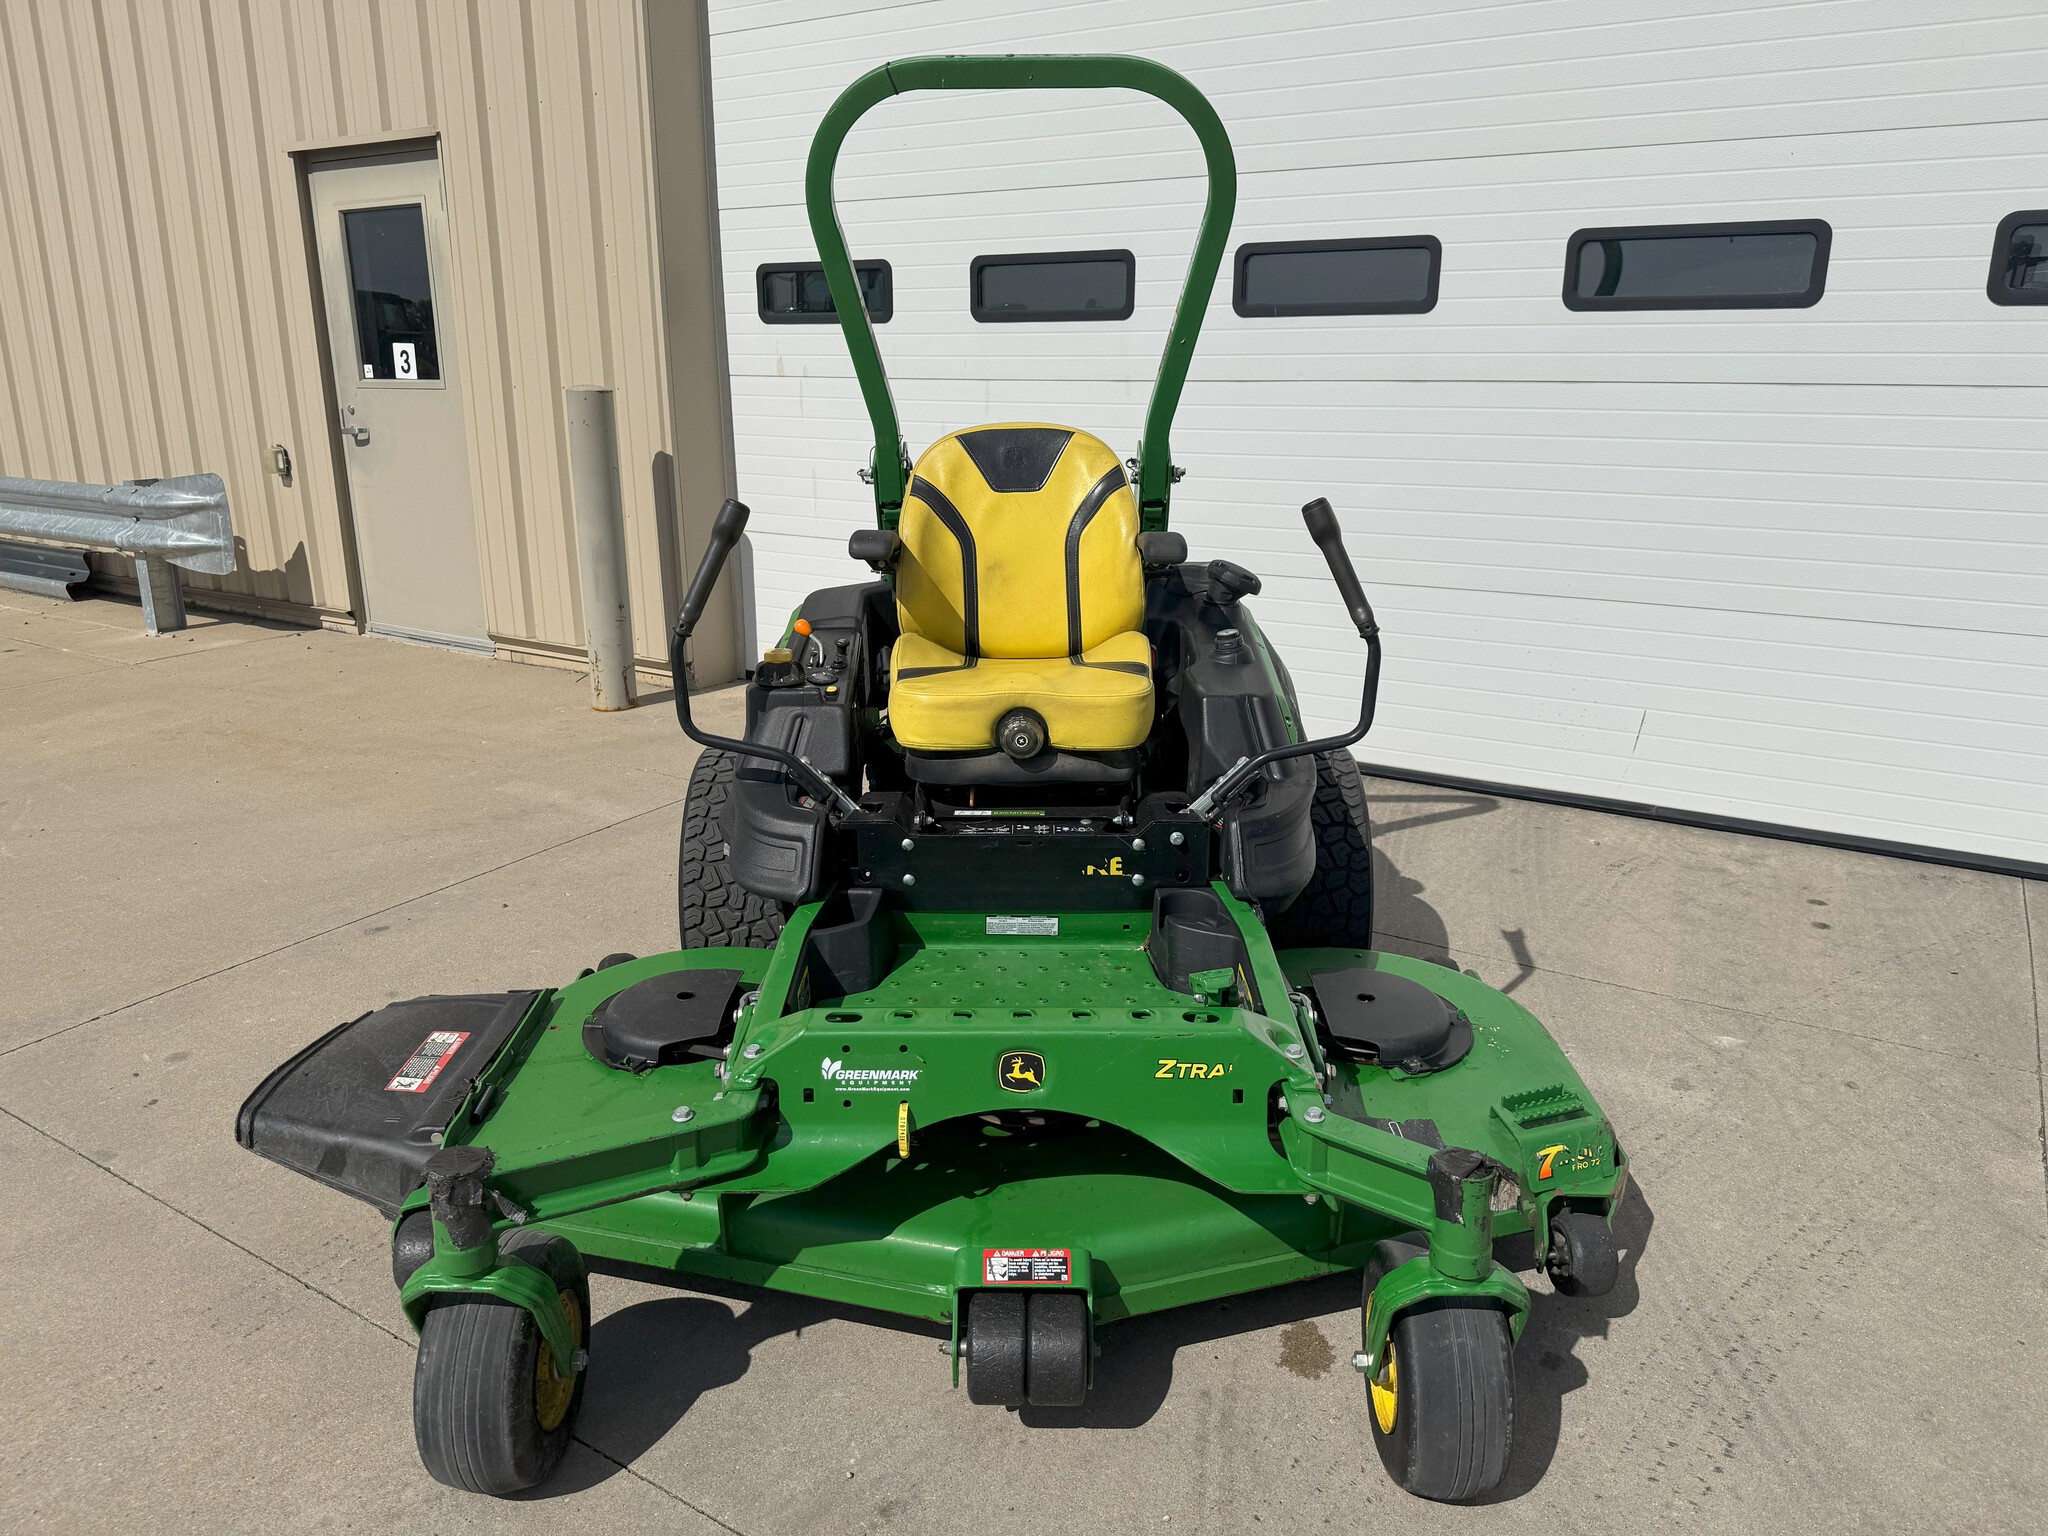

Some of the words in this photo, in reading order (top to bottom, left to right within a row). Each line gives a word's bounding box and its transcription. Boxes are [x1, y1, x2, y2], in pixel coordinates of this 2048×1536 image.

[399, 349, 411, 374] 3
[835, 1070, 918, 1080] GREENMARK
[1154, 1059, 1232, 1079] ZTRA
[1591, 1158, 1601, 1167] 72
